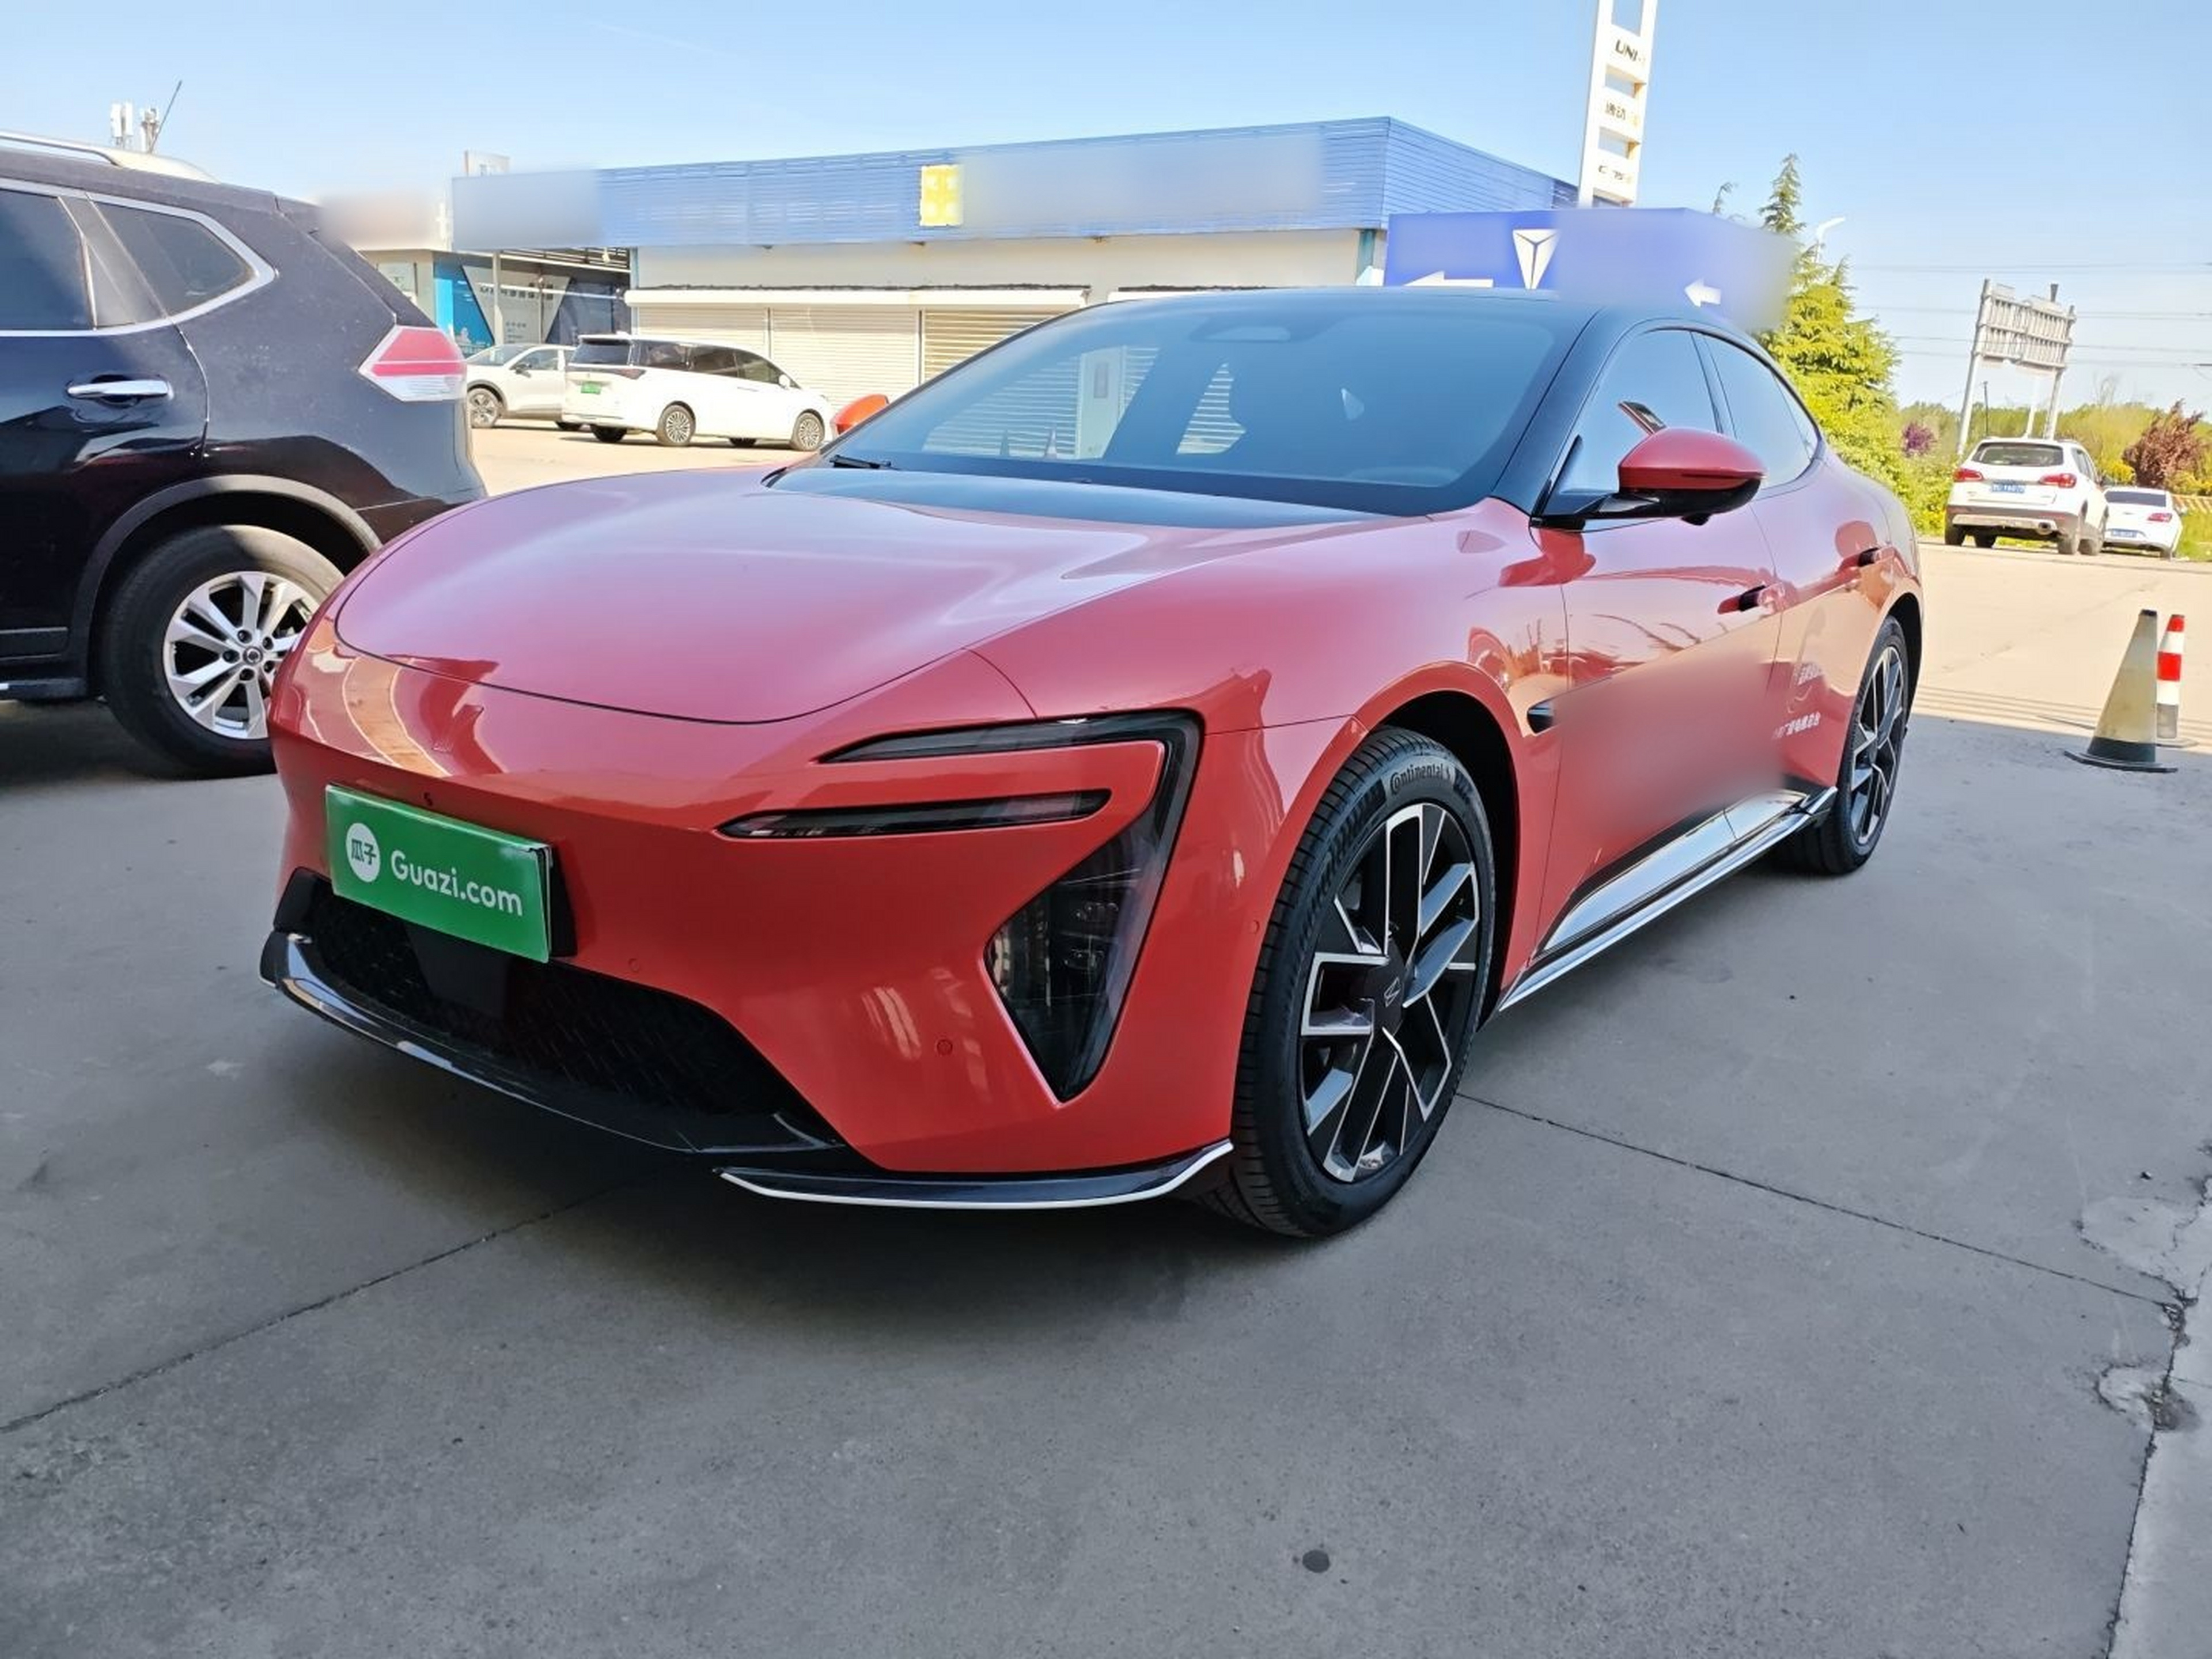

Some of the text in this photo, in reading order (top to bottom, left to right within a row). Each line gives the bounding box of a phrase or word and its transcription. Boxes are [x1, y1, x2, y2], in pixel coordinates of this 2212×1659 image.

[1389, 763, 1443, 796] Continental
[350, 838, 377, 865] 瓜子
[391, 850, 523, 917] Guazi.com
